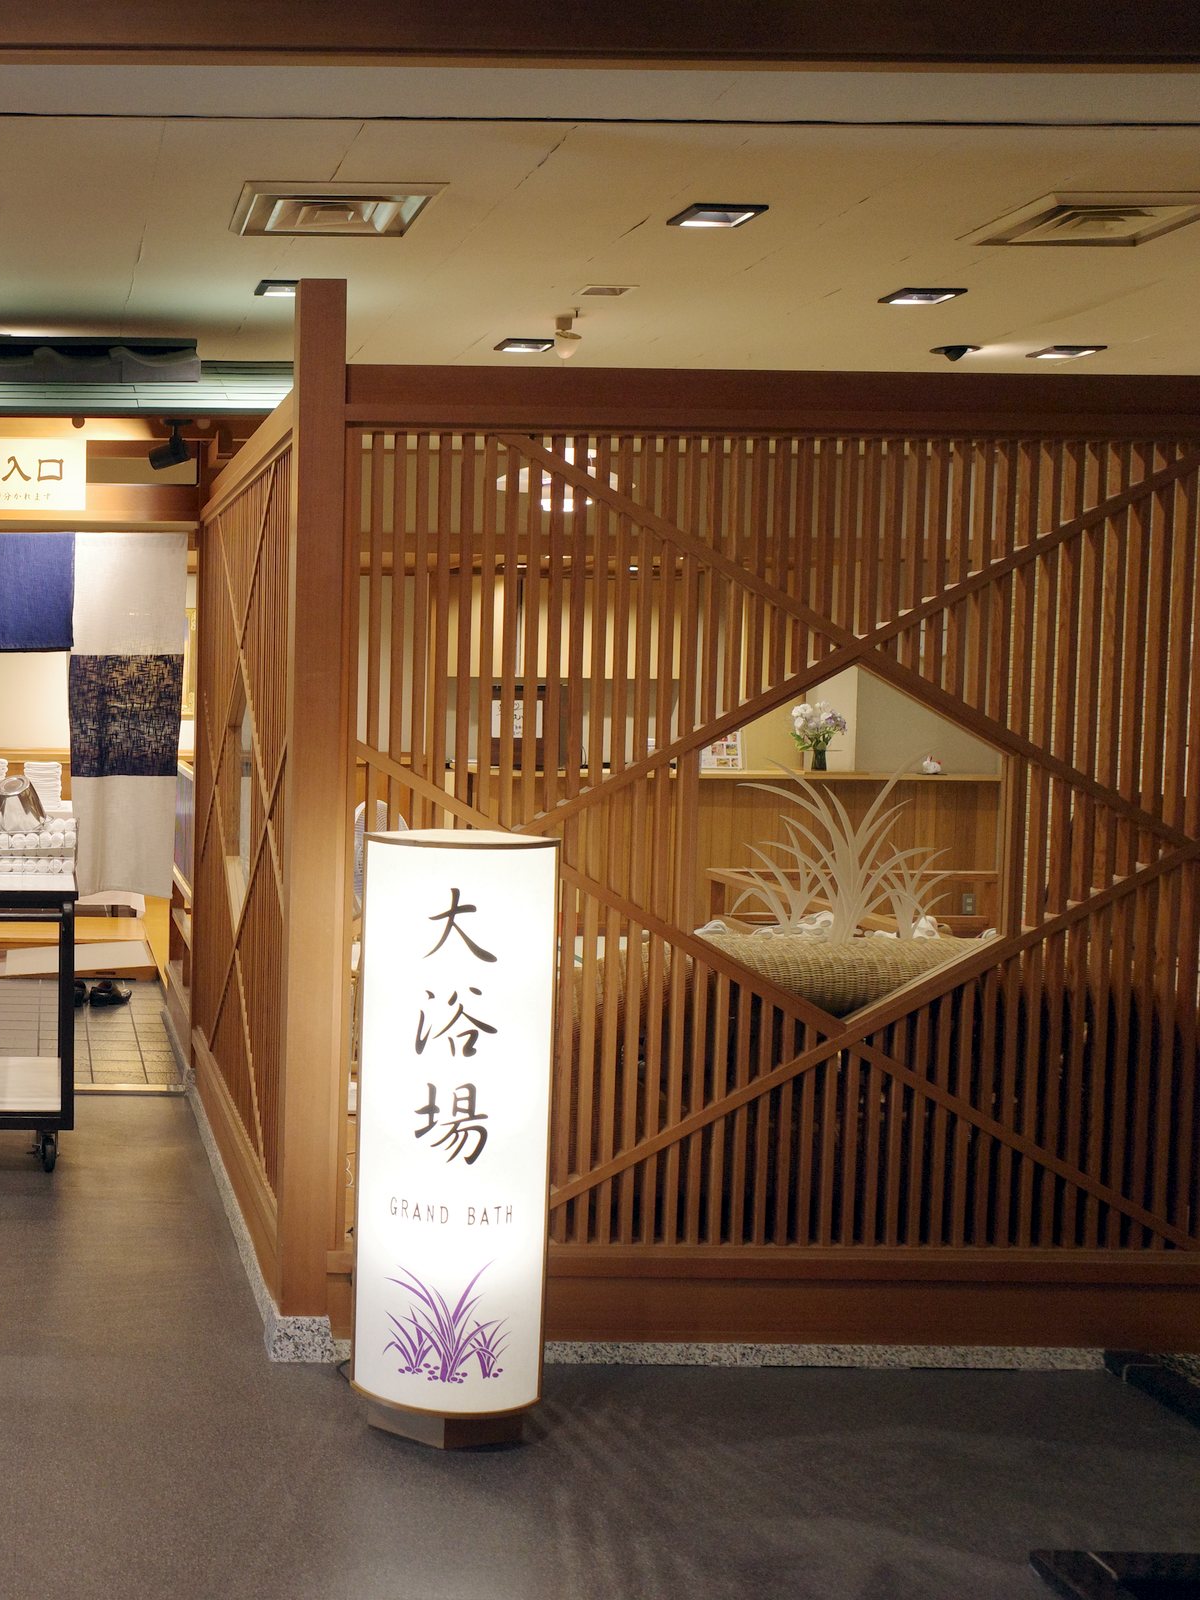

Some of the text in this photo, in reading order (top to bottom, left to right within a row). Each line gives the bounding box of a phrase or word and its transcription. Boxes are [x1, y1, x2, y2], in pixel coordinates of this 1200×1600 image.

[413, 887, 498, 1166] 大浴場
[389, 1195, 513, 1226] GRAND BATH
